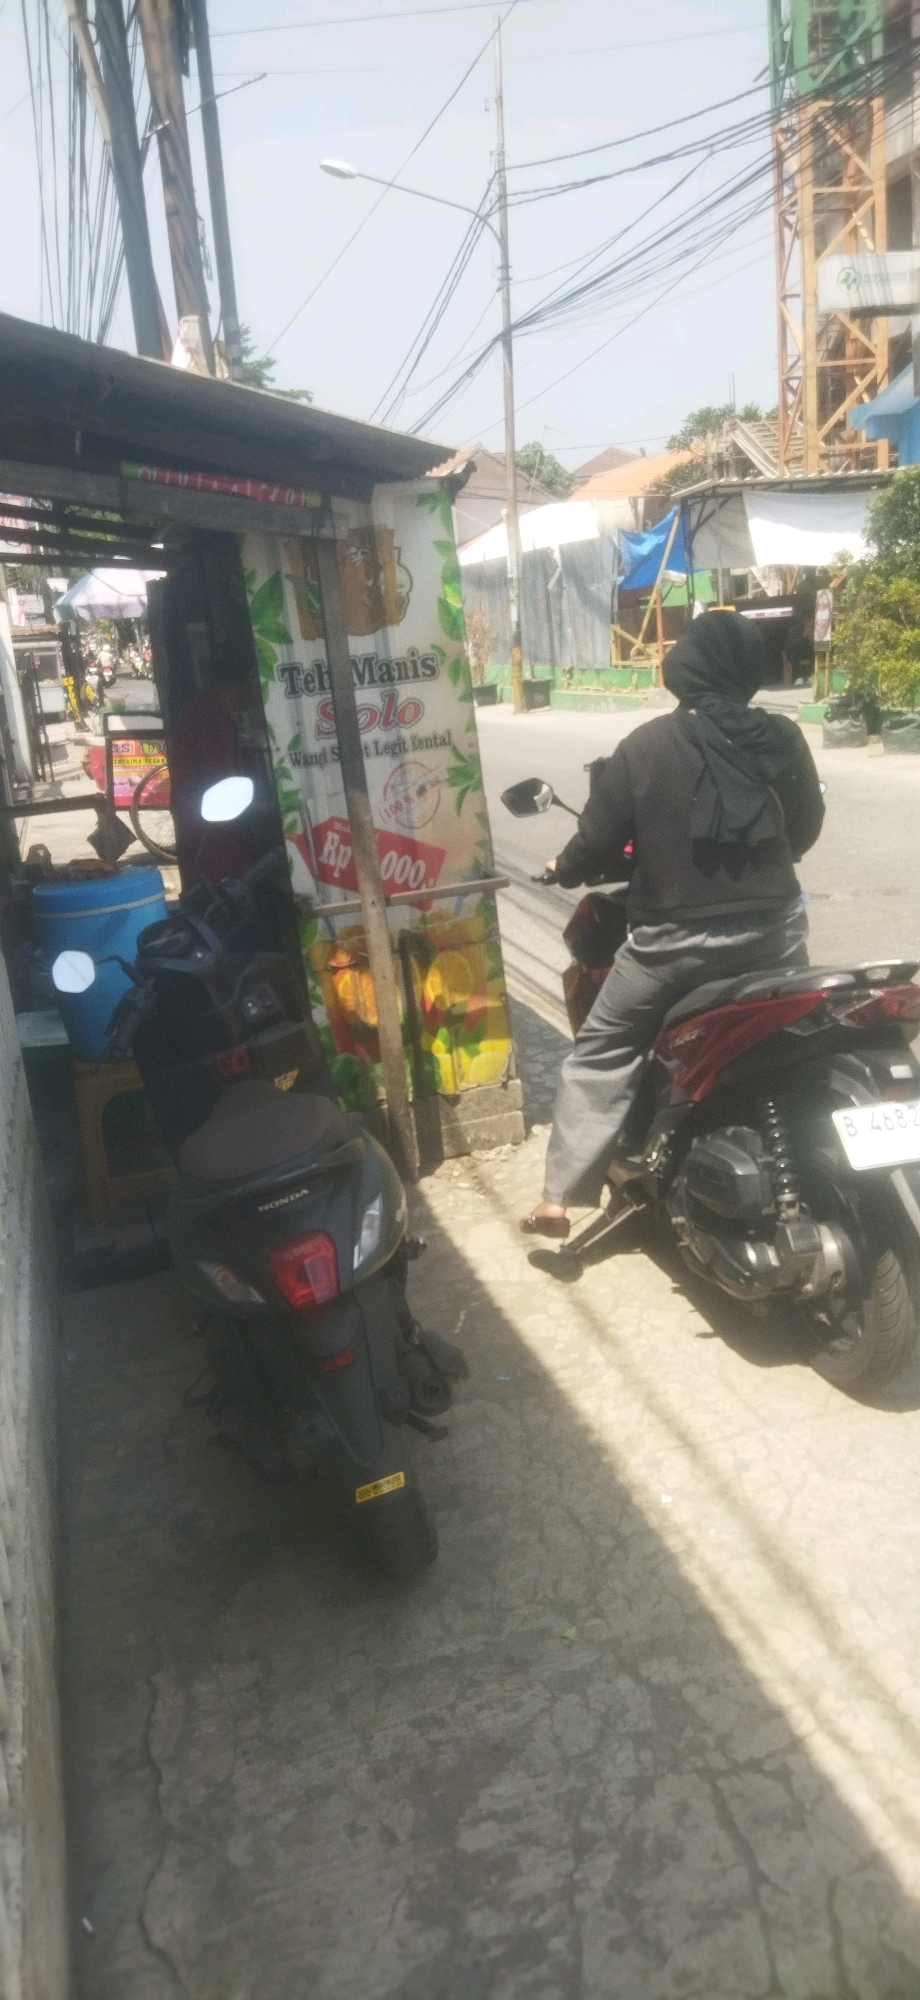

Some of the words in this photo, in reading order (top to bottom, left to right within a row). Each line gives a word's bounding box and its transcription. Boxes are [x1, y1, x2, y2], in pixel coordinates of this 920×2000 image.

[278, 659, 332, 699] Teh
[350, 647, 440, 690] Manis
[315, 688, 425, 741] Solo
[373, 737, 408, 760] Legit
[410, 730, 452, 751] Kental
[842, 1115, 858, 1137] B
[869, 1105, 920, 1134] 4682
[257, 1188, 310, 1212] HONDA
